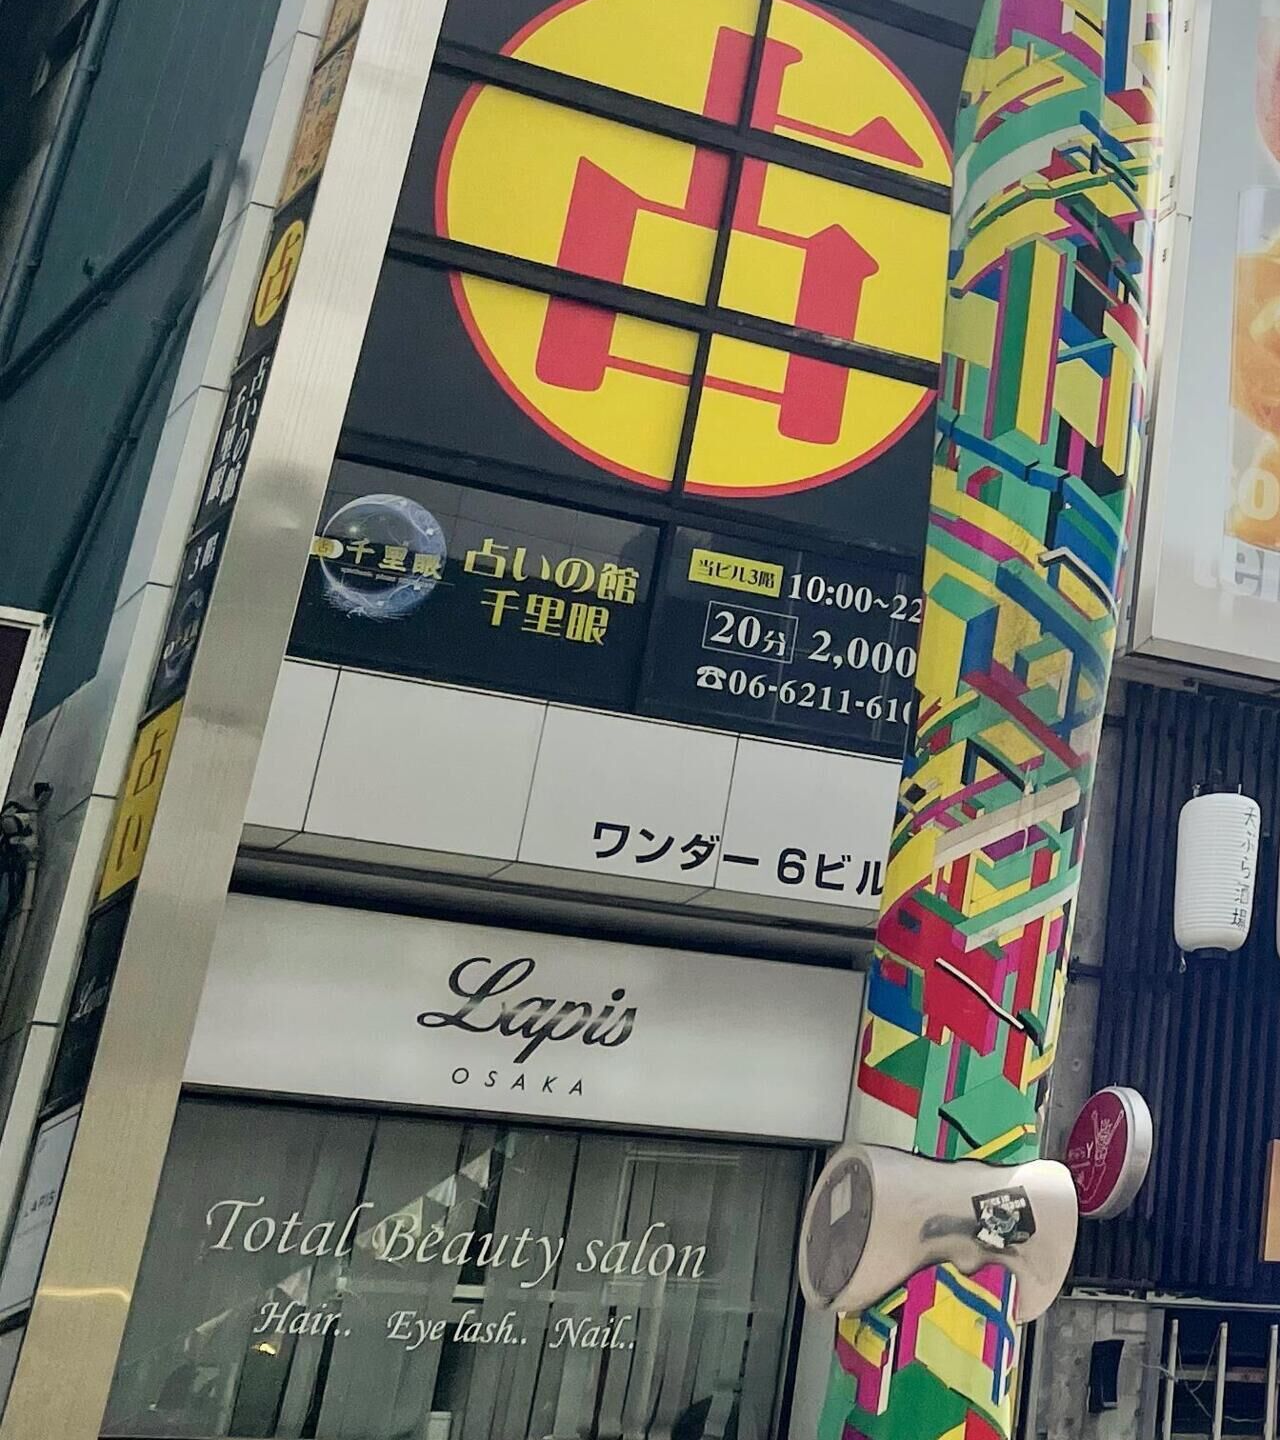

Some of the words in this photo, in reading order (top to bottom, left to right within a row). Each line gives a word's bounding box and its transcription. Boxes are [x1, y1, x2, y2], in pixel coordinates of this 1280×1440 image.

[536, 26, 923, 446] 占
[346, 537, 442, 580] 千里眼
[464, 537, 640, 605] 占いの館
[480, 588, 610, 647] 千里眼
[710, 610, 786, 657] 20分
[808, 629, 917, 679] 2,000
[417, 957, 638, 1064] Lapis
[452, 1067, 584, 1096] OSAKA
[206, 1196, 375, 1257] Total
[371, 1212, 565, 1289] Beauty
[576, 1222, 707, 1279] salon
